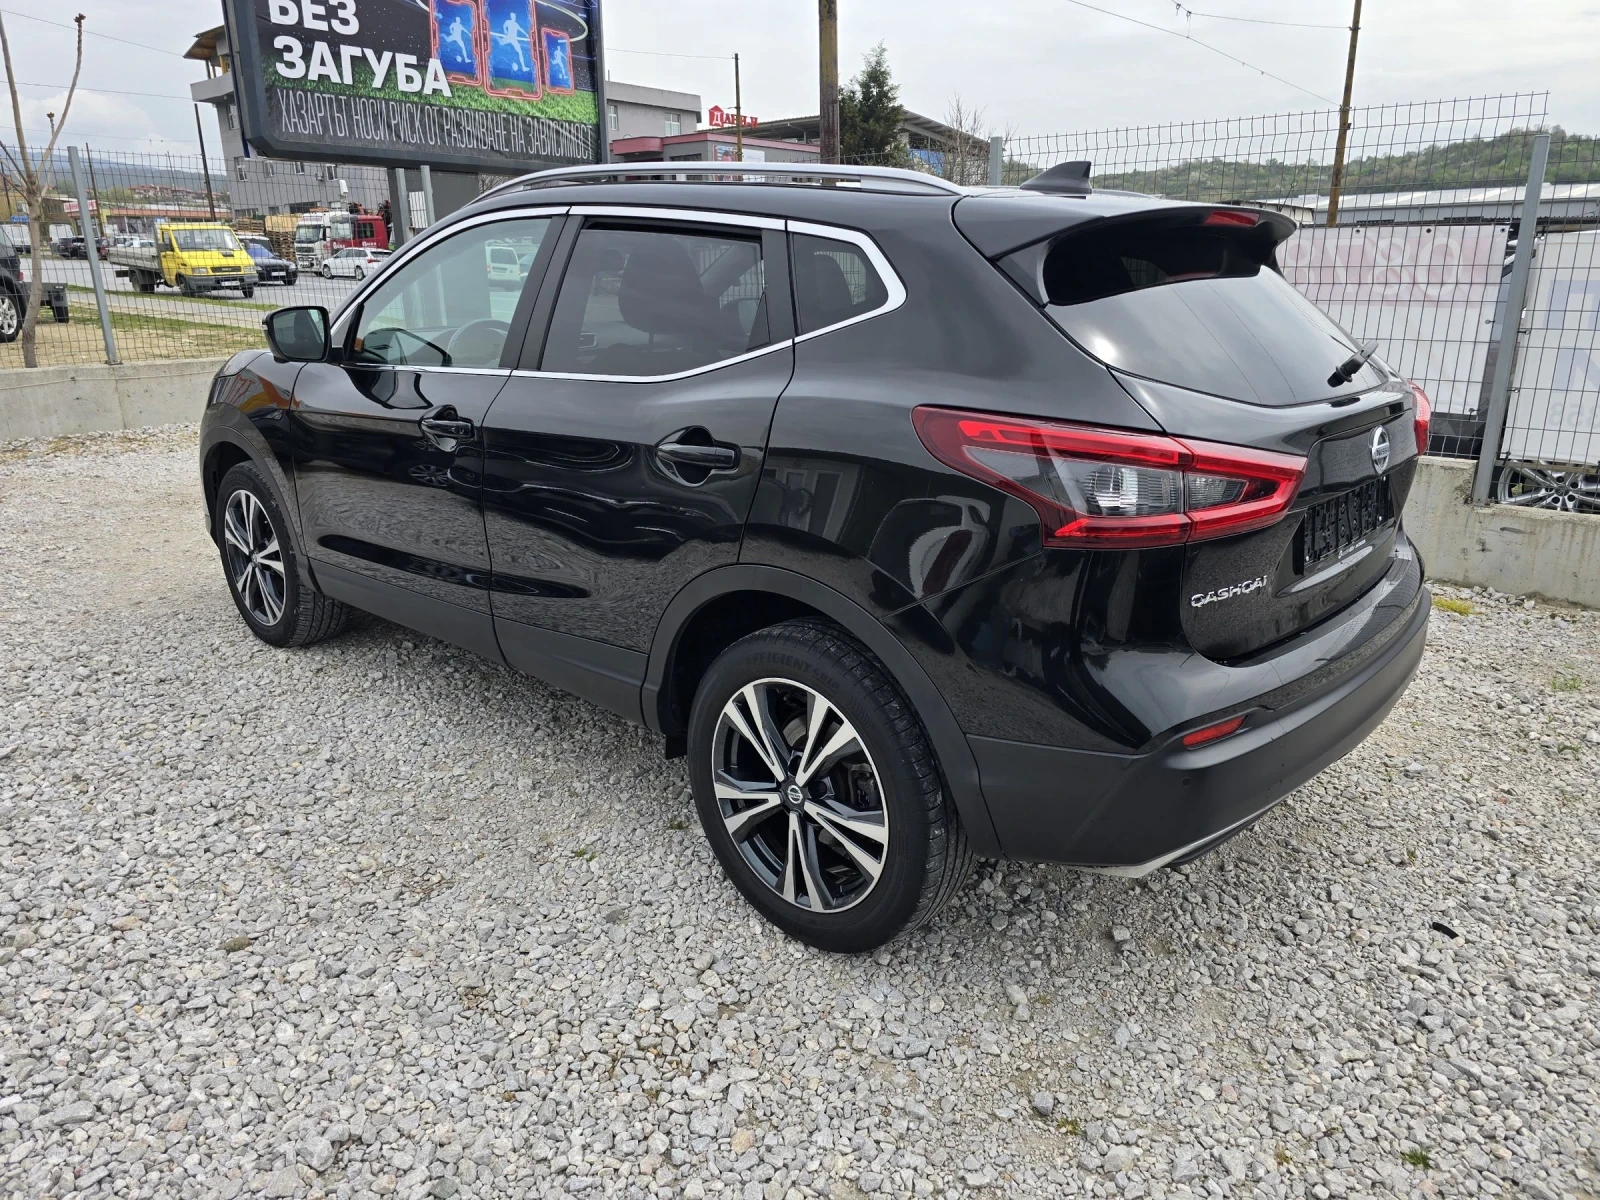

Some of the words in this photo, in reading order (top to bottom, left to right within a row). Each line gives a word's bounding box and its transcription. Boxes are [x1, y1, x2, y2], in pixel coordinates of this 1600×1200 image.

[269, 0, 359, 35] БЕЗ
[273, 35, 453, 97] ЗАГУБА
[277, 88, 349, 137] ХАЗАРТЪТ
[351, 97, 389, 140] НОСИ
[389, 101, 425, 144] РИСК
[425, 105, 440, 145] ОТ
[443, 107, 509, 152] РАЗВИВАНЕ
[510, 116, 526, 153] НА
[527, 117, 592, 160] ЗАВИСИМОСТ
[1190, 574, 1268, 608] QASHQAI
